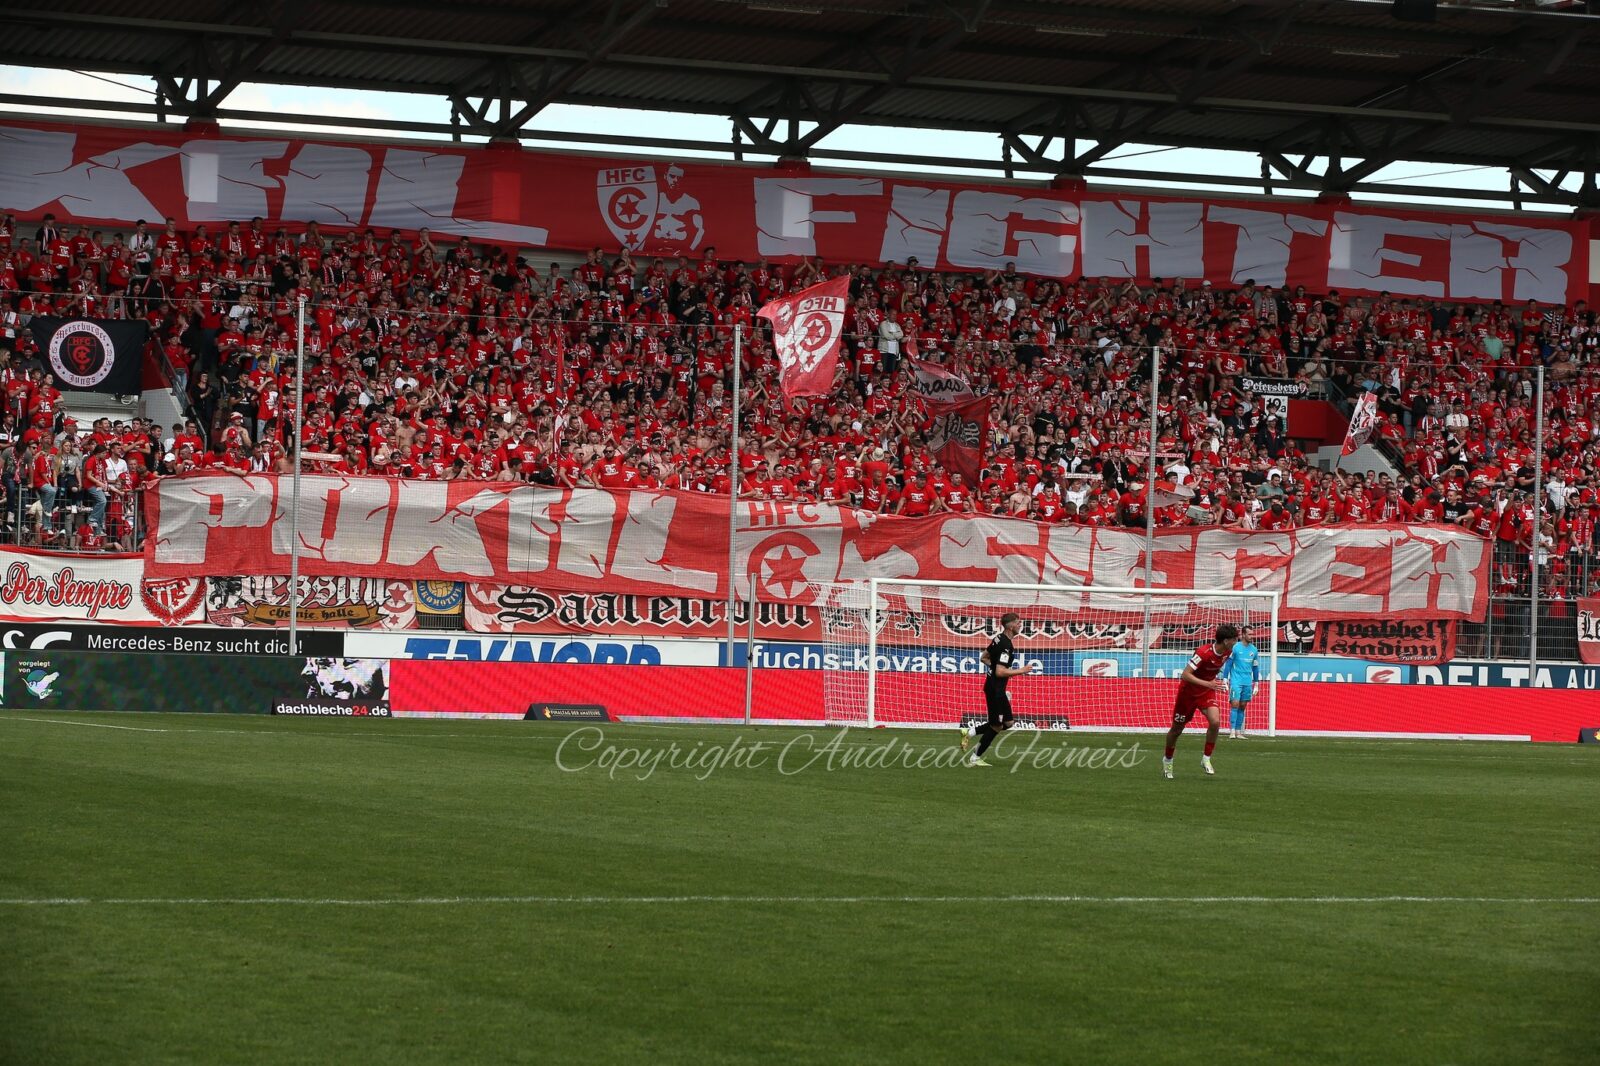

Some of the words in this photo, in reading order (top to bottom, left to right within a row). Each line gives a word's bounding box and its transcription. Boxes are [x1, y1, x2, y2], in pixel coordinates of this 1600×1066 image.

[606, 168, 645, 184] HFC
[754, 178, 1572, 304] FIGHTER
[1242, 378, 1298, 394] Petersberg
[750, 500, 821, 526] HFC
[2, 562, 47, 604] Per
[47, 566, 132, 619] Sempre
[87, 633, 211, 652] Mercedes-Benz
[216, 639, 260, 654] sucht
[19, 660, 51, 668] vorgelegt
[277, 702, 388, 716] dachbleche24.de
[1174, 714, 1186, 722] 25
